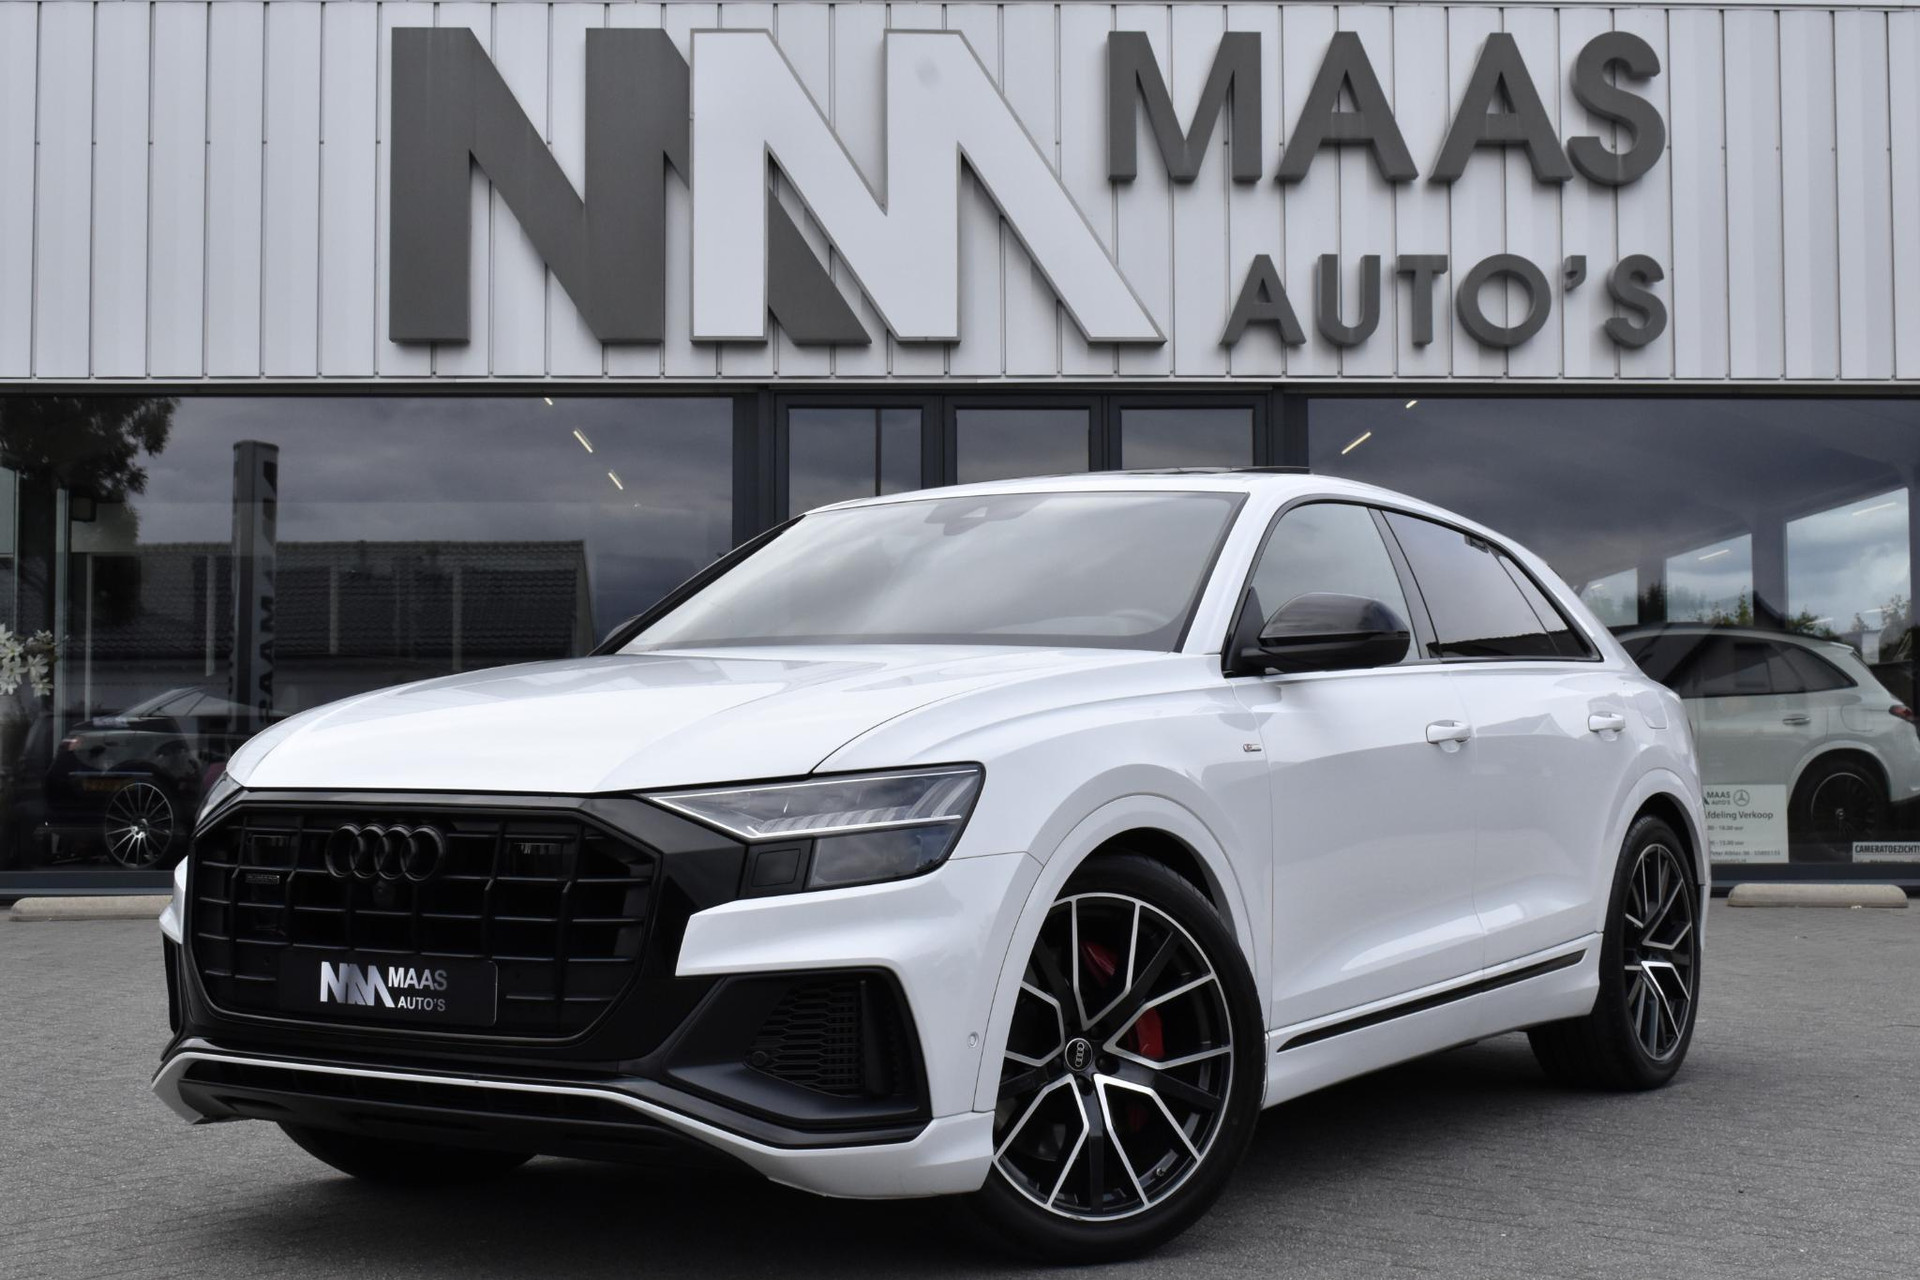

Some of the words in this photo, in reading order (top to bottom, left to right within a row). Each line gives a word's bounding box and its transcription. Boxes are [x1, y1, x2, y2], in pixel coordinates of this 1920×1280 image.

[1108, 30, 1668, 186] MAAS
[1219, 253, 1670, 350] AUTO'S
[1706, 791, 1731, 799] MAAS
[1738, 810, 1774, 821] Verkoop
[388, 966, 448, 992] MAAS
[397, 995, 446, 1012] AUTO'S
